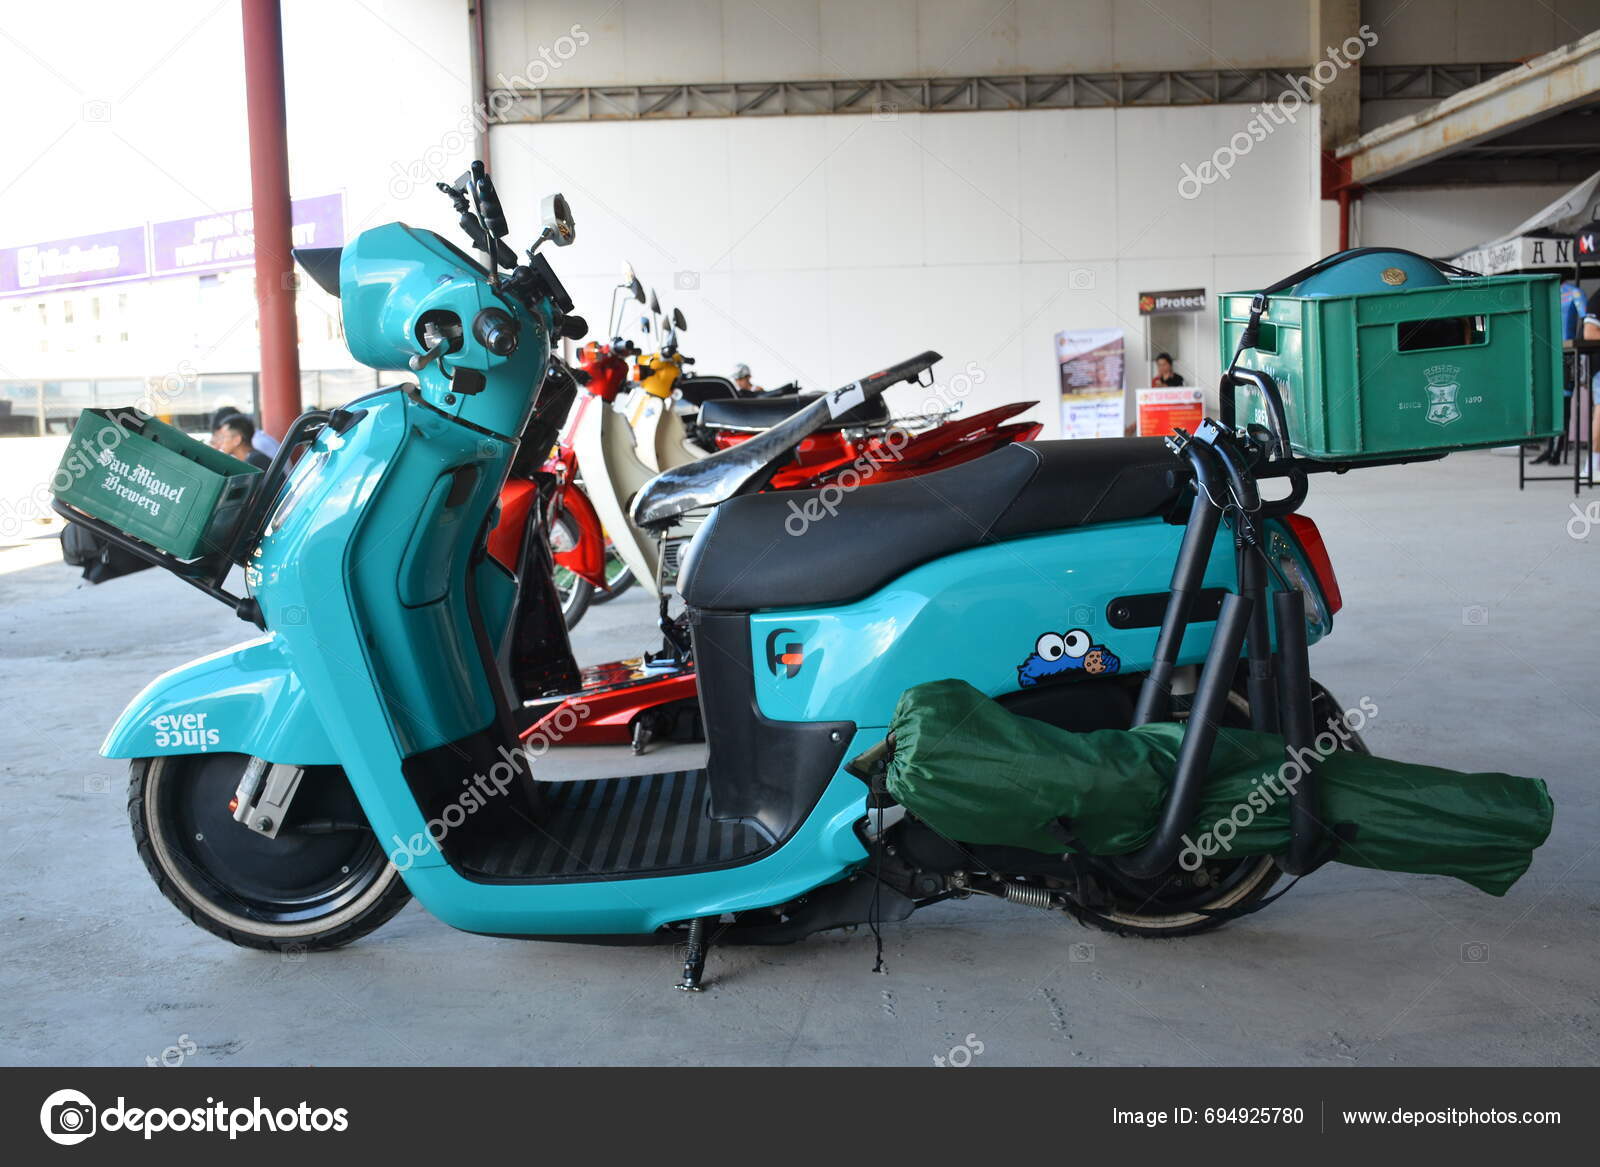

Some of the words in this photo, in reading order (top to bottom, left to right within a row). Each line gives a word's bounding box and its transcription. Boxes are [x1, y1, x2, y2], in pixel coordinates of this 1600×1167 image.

[1155, 294, 1206, 309] iProtect
[97, 448, 131, 478] San
[128, 463, 187, 504] Miguel
[101, 472, 161, 517] Brewery
[154, 713, 207, 731] ever
[155, 728, 220, 753] since
